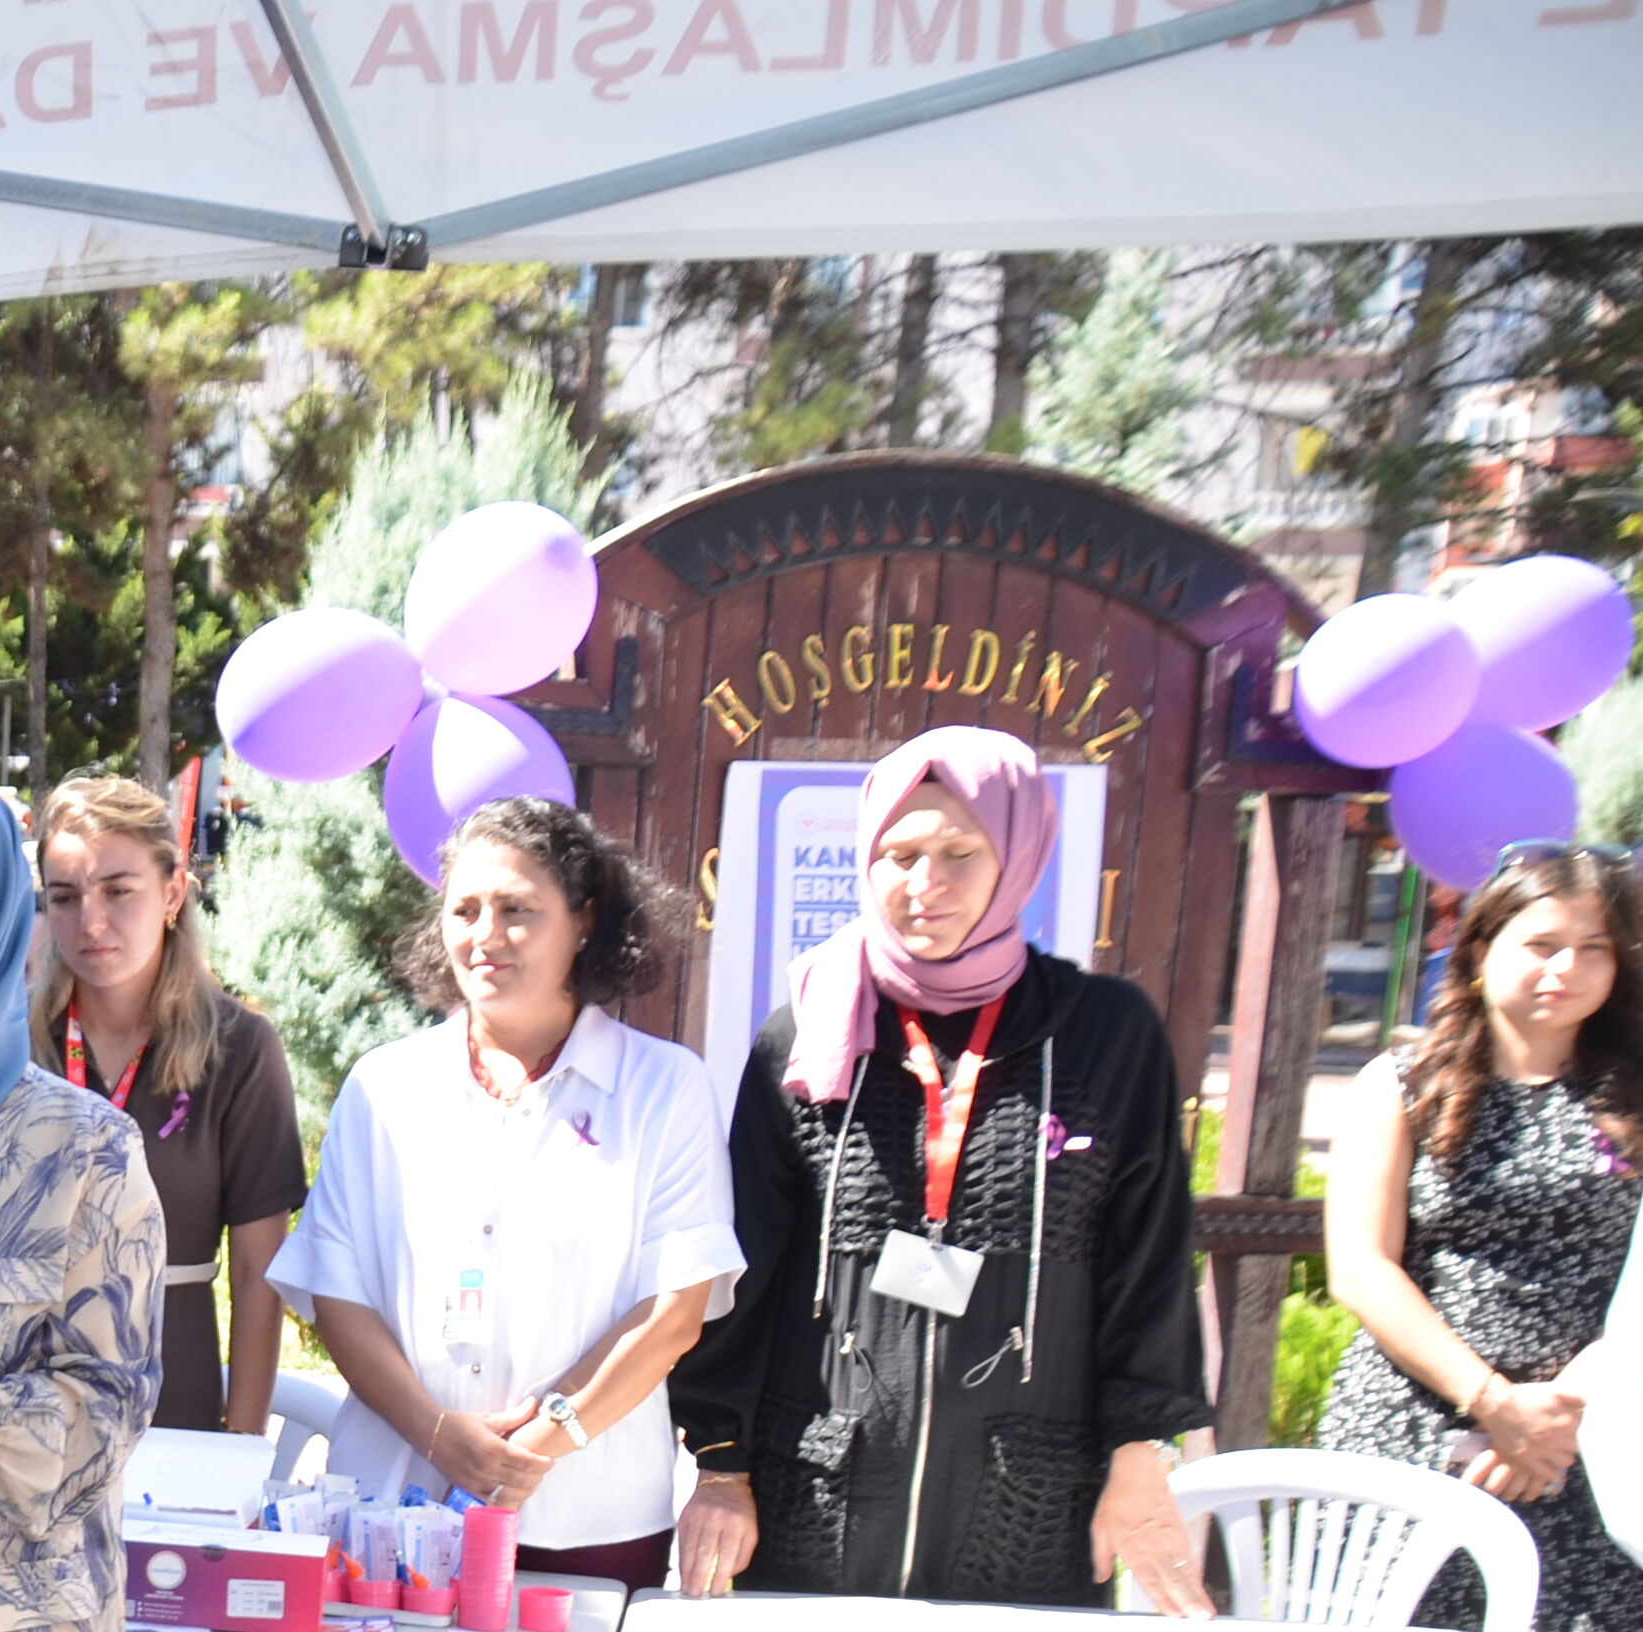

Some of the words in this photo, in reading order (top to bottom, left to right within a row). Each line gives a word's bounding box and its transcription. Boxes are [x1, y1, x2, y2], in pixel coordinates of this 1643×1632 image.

[701, 623, 1144, 765] HOŞGELDİNİZ
[795, 845, 857, 868] KAN
[795, 876, 856, 902] ERK
